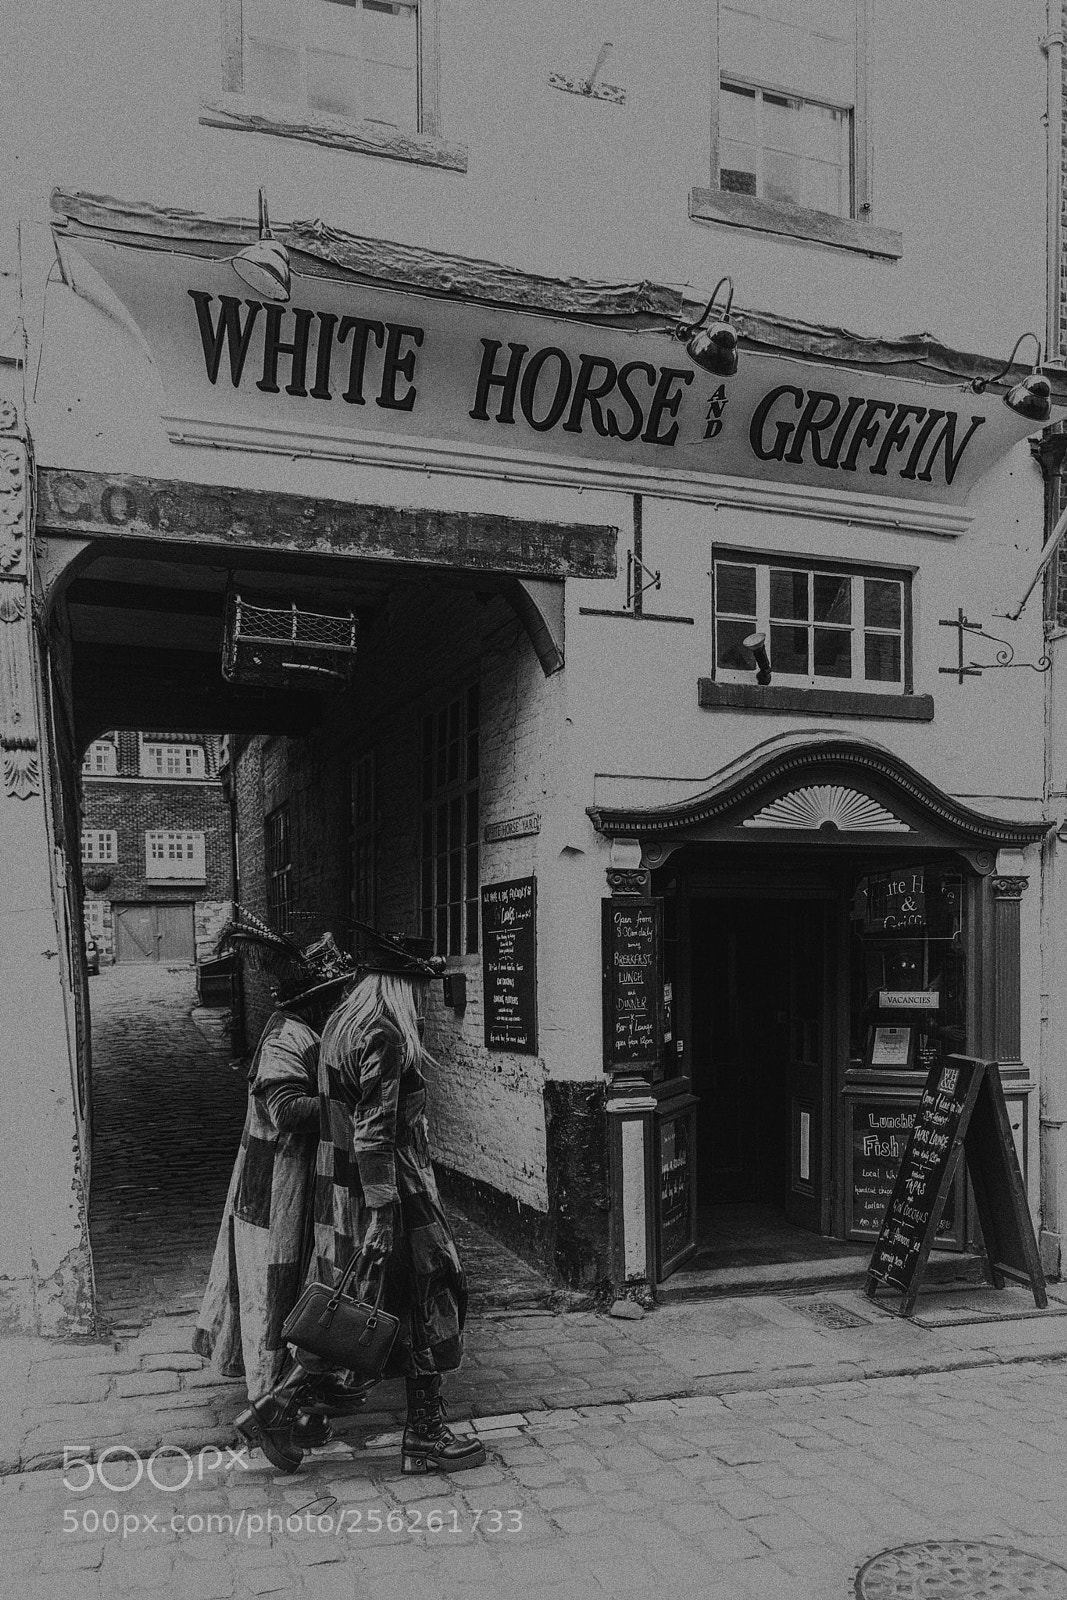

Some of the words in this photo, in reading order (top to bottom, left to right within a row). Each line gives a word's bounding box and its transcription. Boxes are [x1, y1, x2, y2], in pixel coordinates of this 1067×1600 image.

[187, 289, 424, 412] WHITE
[468, 338, 695, 447] HORSE
[703, 384, 729, 440] AND
[749, 384, 986, 486] GRIFFIN
[618, 970, 644, 984] LUNCH
[887, 996, 931, 1005] VACANCIES
[863, 1134, 899, 1158] Fish
